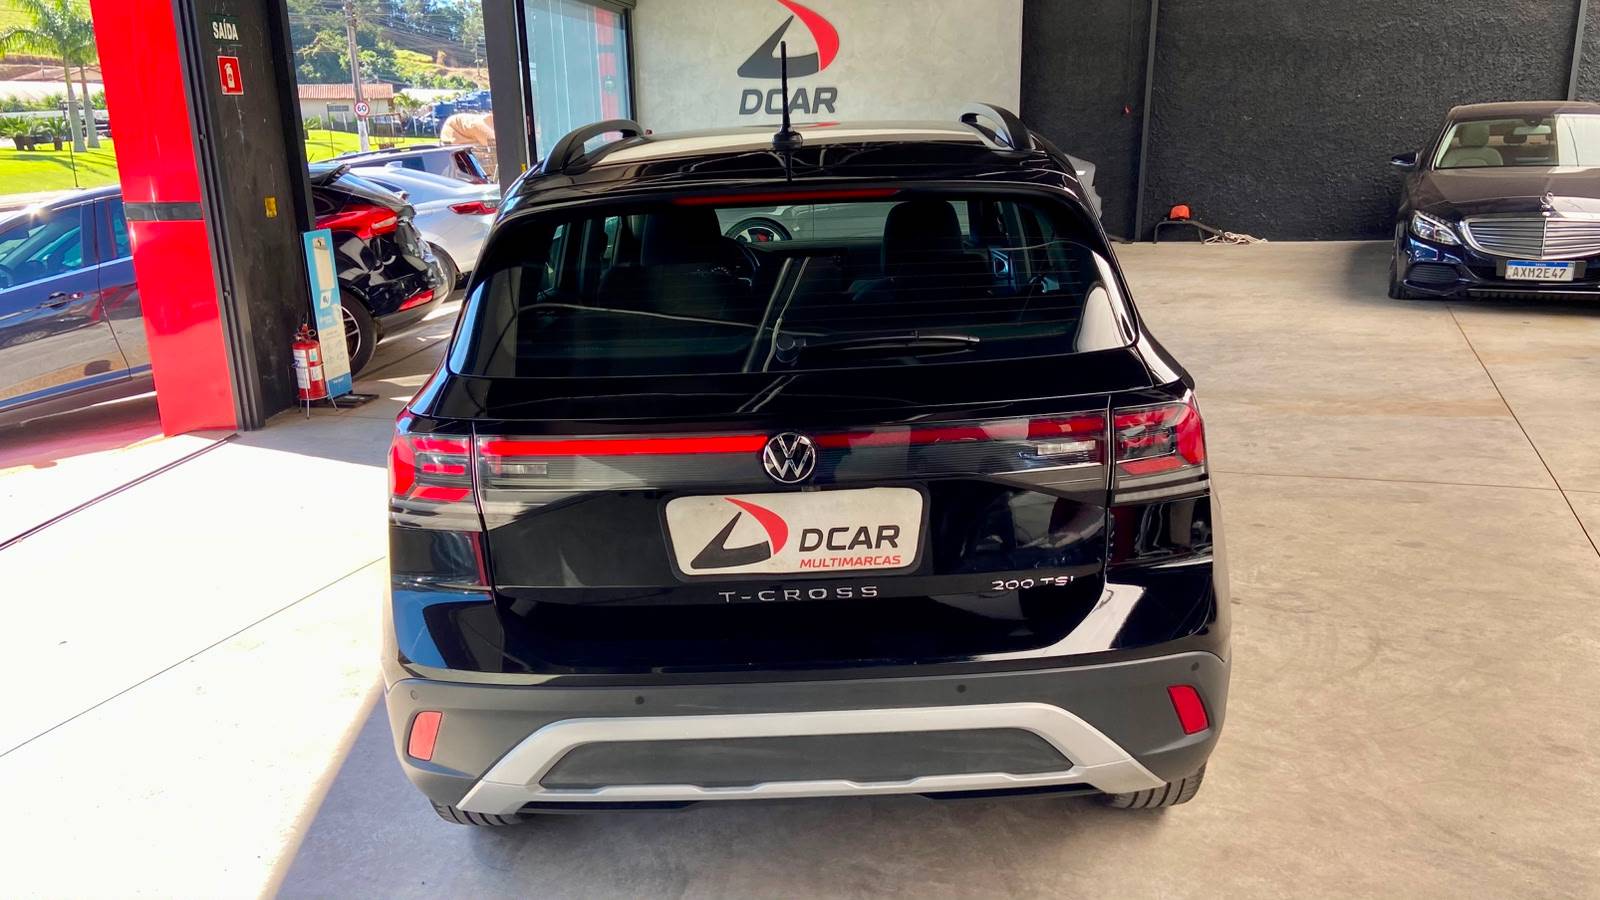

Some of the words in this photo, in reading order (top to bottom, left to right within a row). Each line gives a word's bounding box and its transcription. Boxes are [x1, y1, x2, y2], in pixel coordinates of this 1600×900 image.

[212, 18, 239, 41] SAÍDA
[739, 87, 838, 115] DCAR
[1512, 267, 1567, 279] AXM2E47
[799, 525, 900, 552] DCAR
[800, 555, 902, 568] MULTIMARCAS
[991, 579, 1034, 590] 200
[718, 586, 878, 603] T-CROSS
